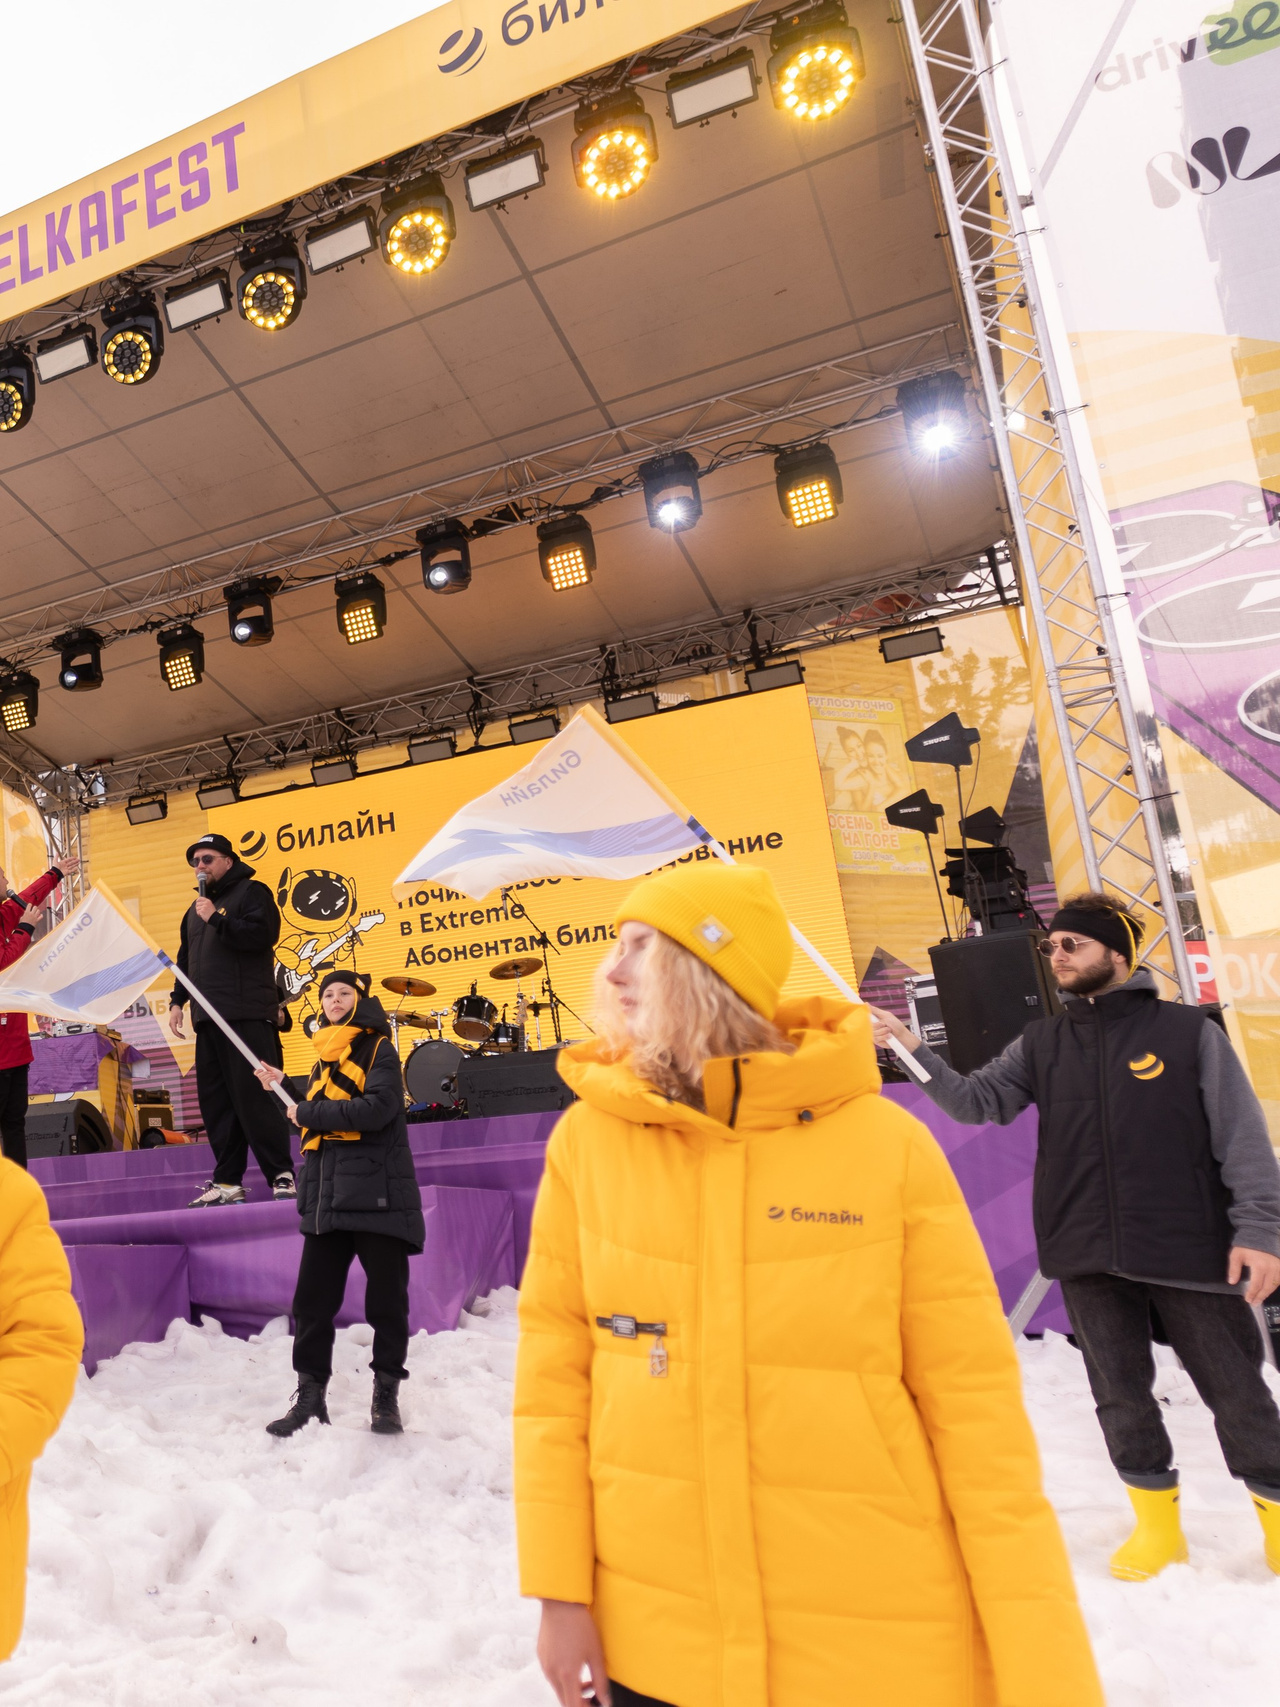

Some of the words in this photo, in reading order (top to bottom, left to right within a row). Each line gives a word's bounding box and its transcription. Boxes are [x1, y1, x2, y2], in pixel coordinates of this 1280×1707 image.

[923, 735, 951, 747] SHURE
[276, 809, 396, 852] билайн
[842, 832, 860, 846] НА
[865, 834, 899, 848] ГОРЕ
[400, 921, 413, 936] в
[420, 903, 525, 934] Extreme
[404, 934, 548, 969] Абонентам
[478, 1085, 559, 1099] ProTone
[791, 1207, 863, 1226] билайн
